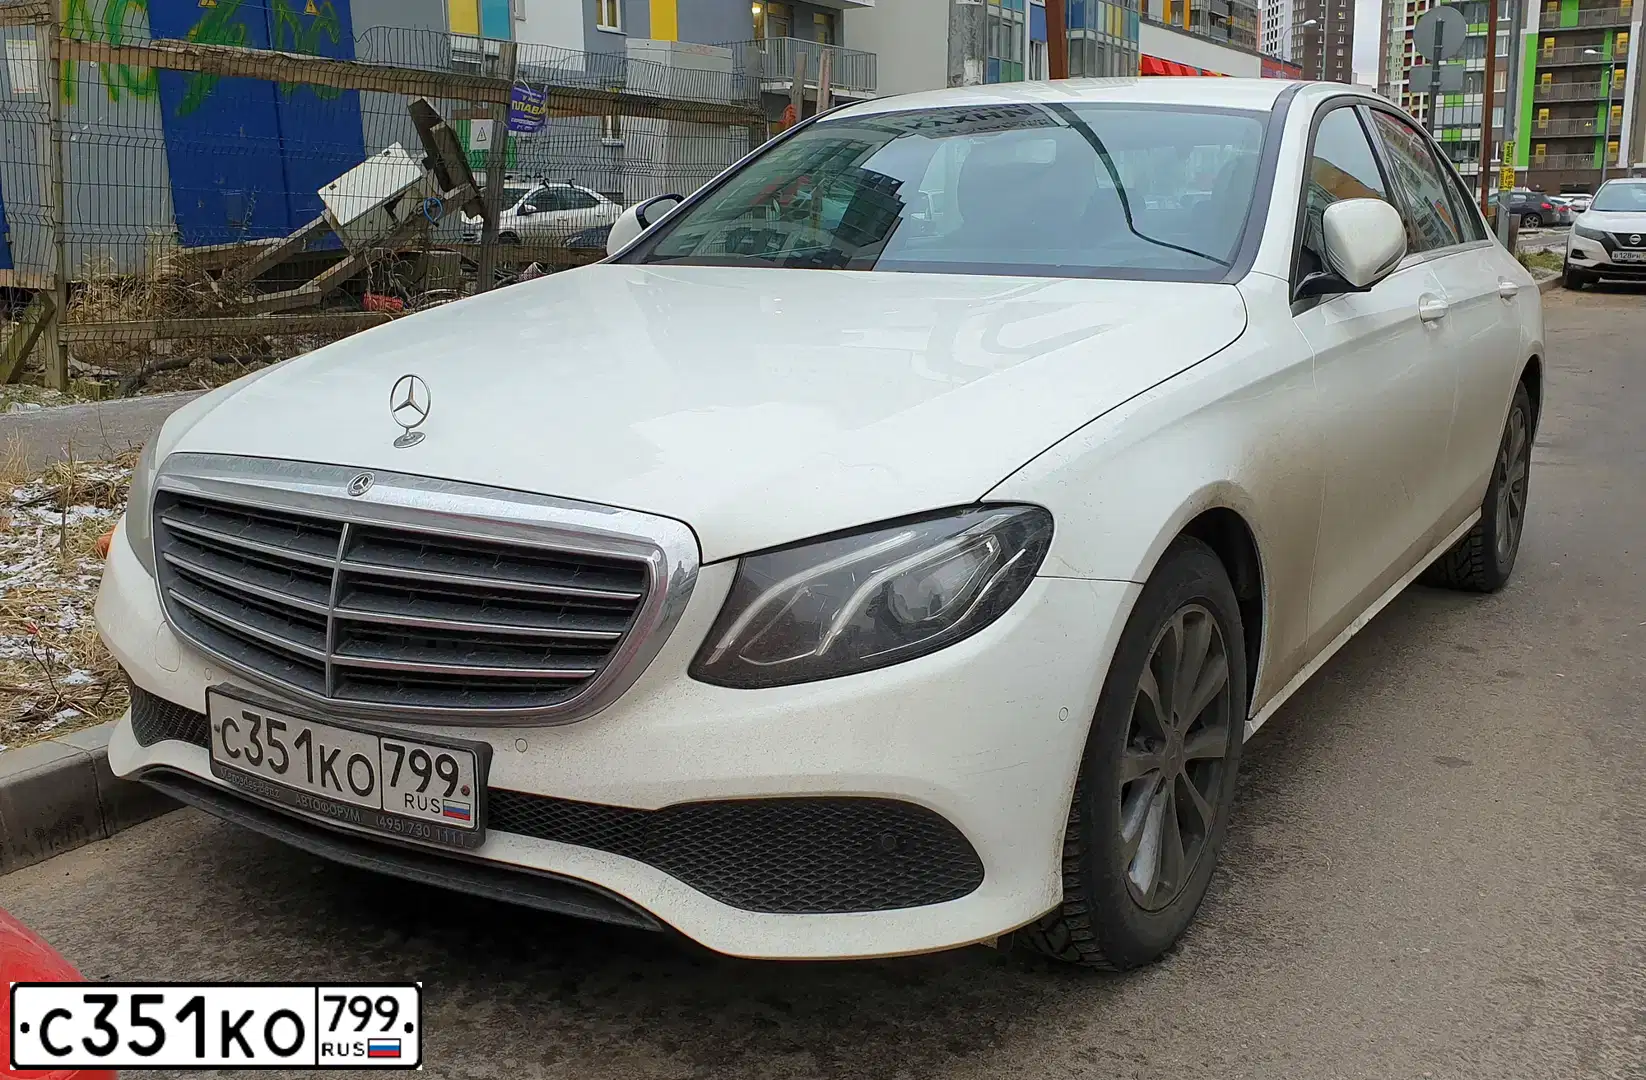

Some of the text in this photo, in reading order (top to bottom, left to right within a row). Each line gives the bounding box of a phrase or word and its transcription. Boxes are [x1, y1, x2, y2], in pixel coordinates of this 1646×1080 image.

[383, 743, 459, 798] 799
[295, 793, 361, 822] АВТОФОРУМ
[404, 792, 441, 814] RUS
[376, 815, 405, 832] (495)
[408, 822, 431, 838] 730
